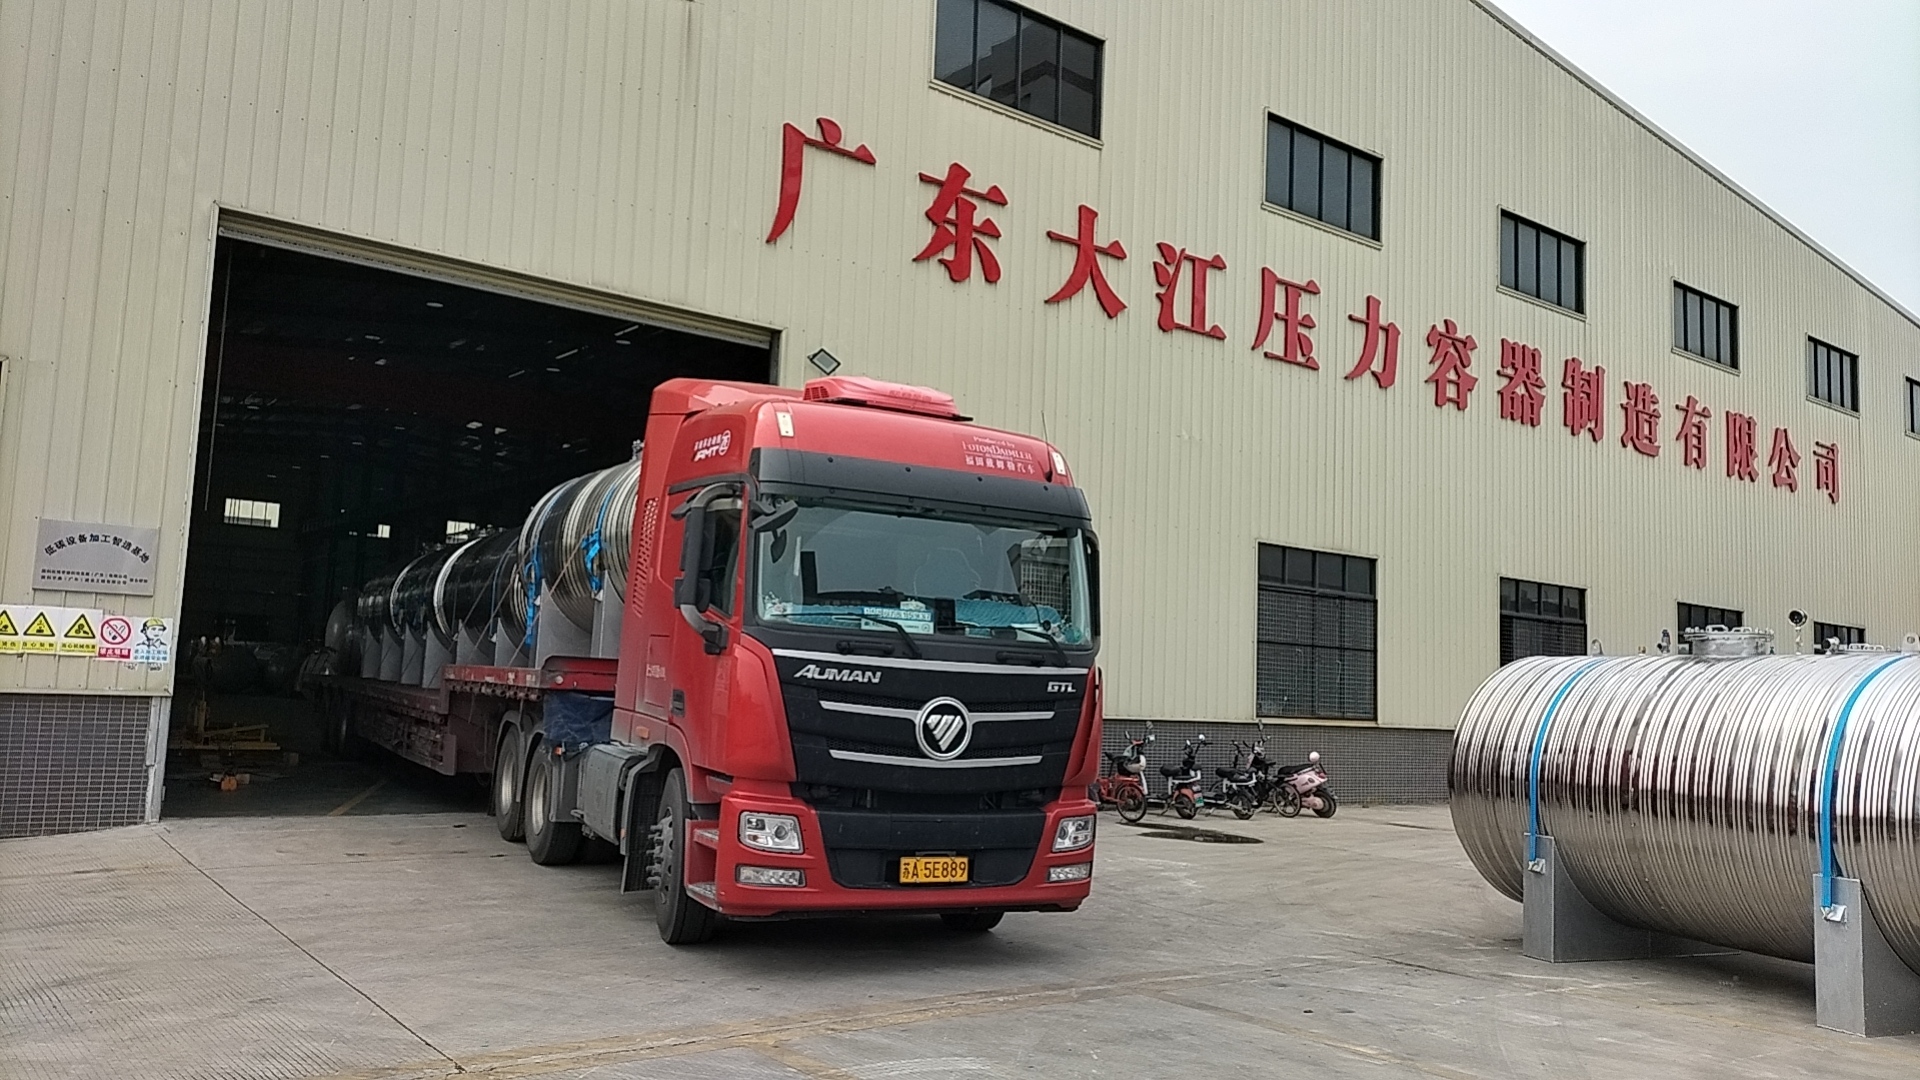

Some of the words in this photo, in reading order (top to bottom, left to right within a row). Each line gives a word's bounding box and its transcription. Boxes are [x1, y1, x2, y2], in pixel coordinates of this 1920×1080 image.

[765, 116, 1841, 504] 广东大江压力容器制造有限公司
[973, 436, 1005, 446] Produced
[693, 445, 720, 462] AMT
[793, 664, 882, 683] AUMAN
[1047, 681, 1077, 693] GTL
